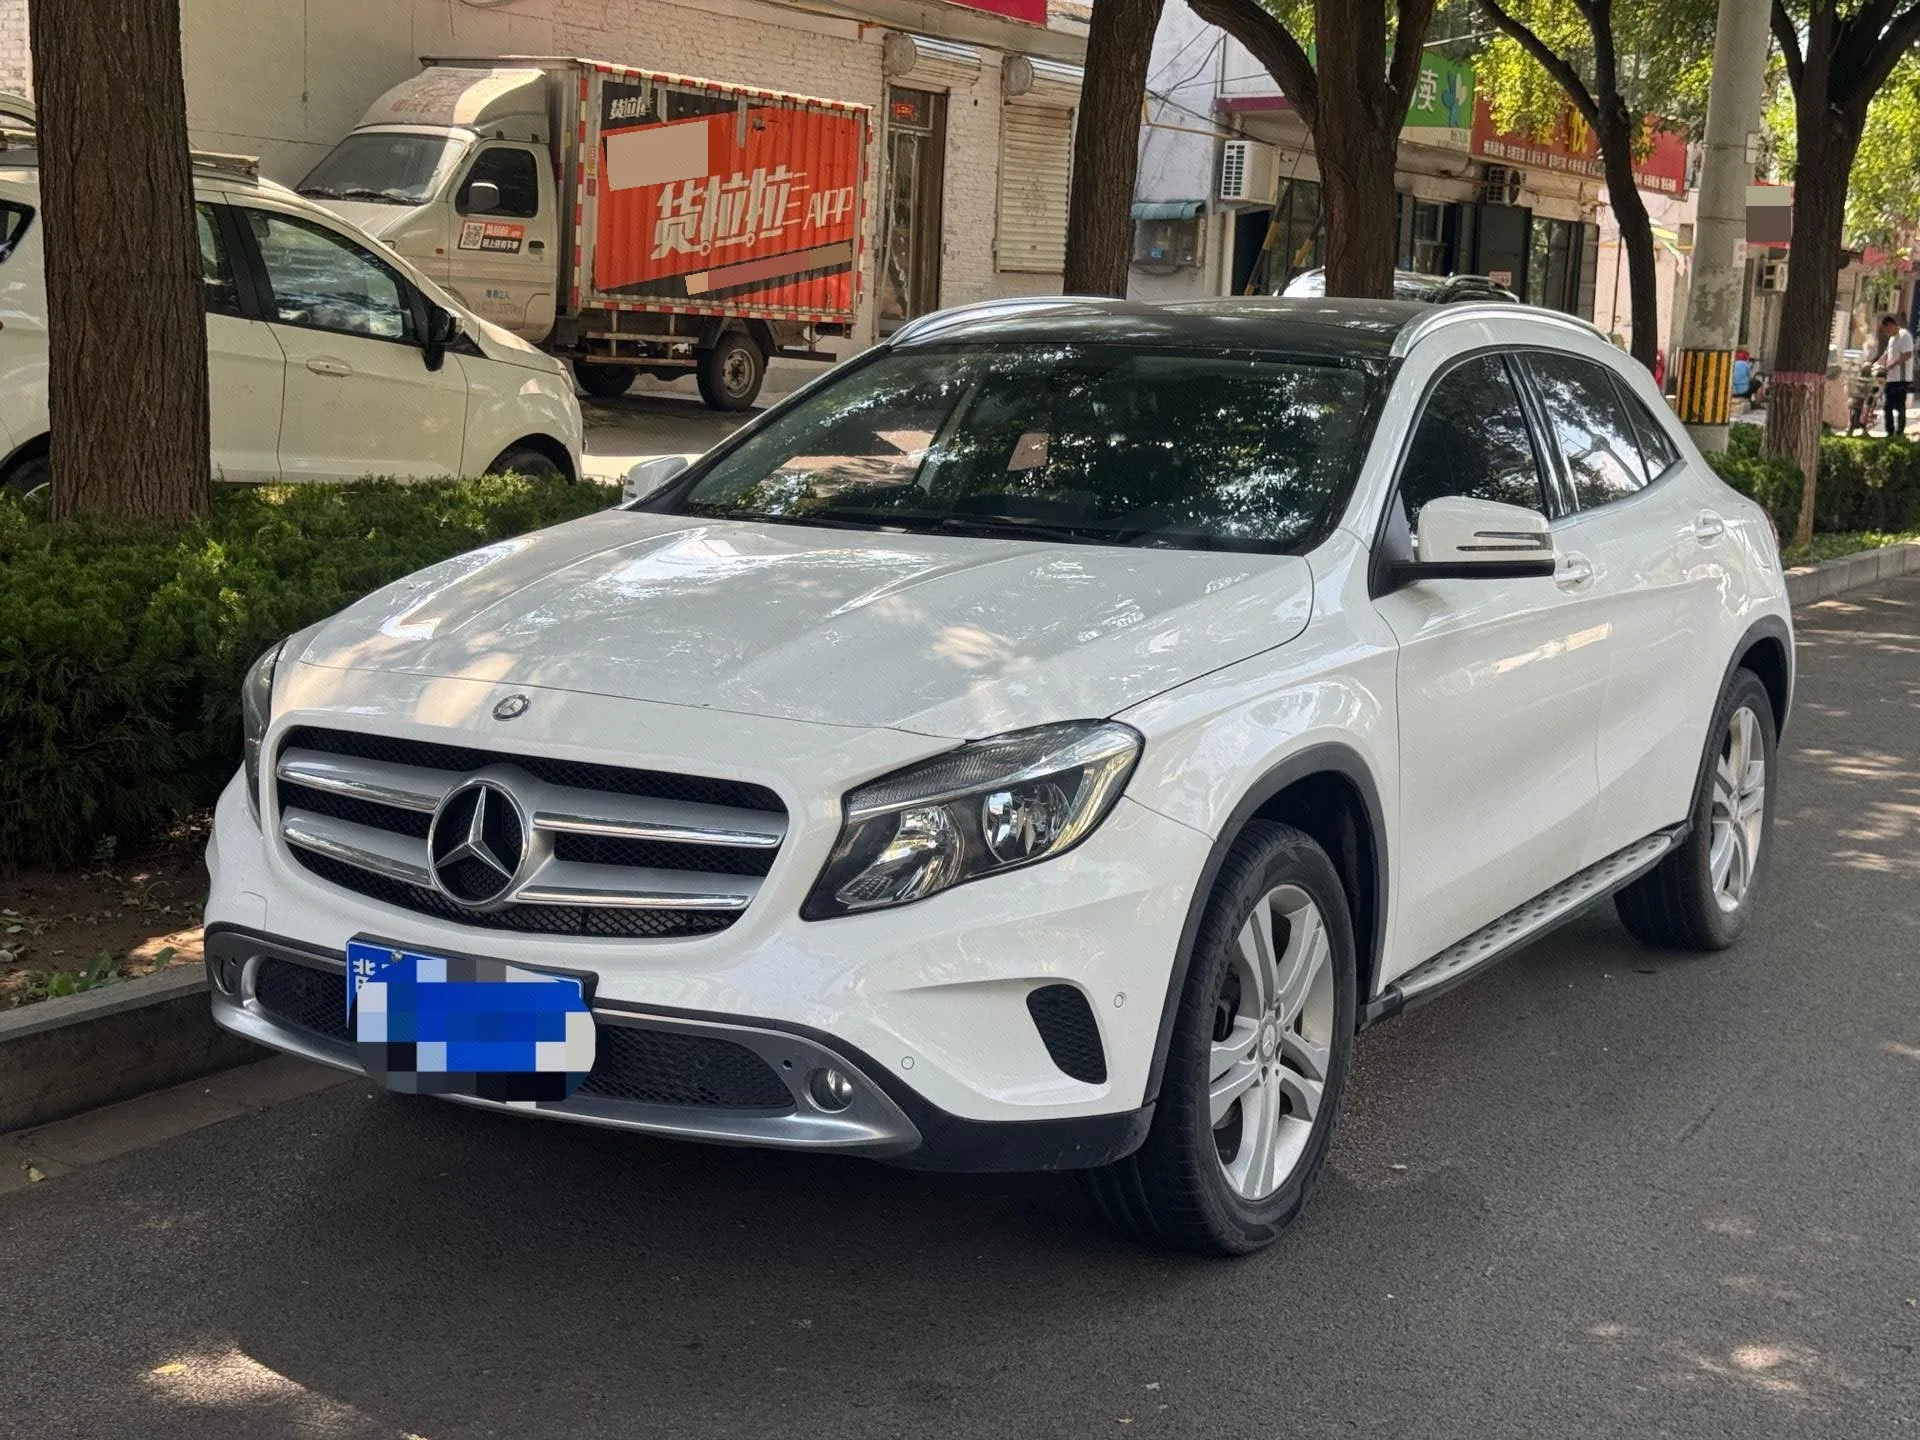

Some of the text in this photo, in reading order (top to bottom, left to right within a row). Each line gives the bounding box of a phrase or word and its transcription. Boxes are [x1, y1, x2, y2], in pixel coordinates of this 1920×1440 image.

[1410, 69, 1439, 113] 卖
[651, 165, 793, 260] 货拉拉
[803, 186, 854, 230] APP
